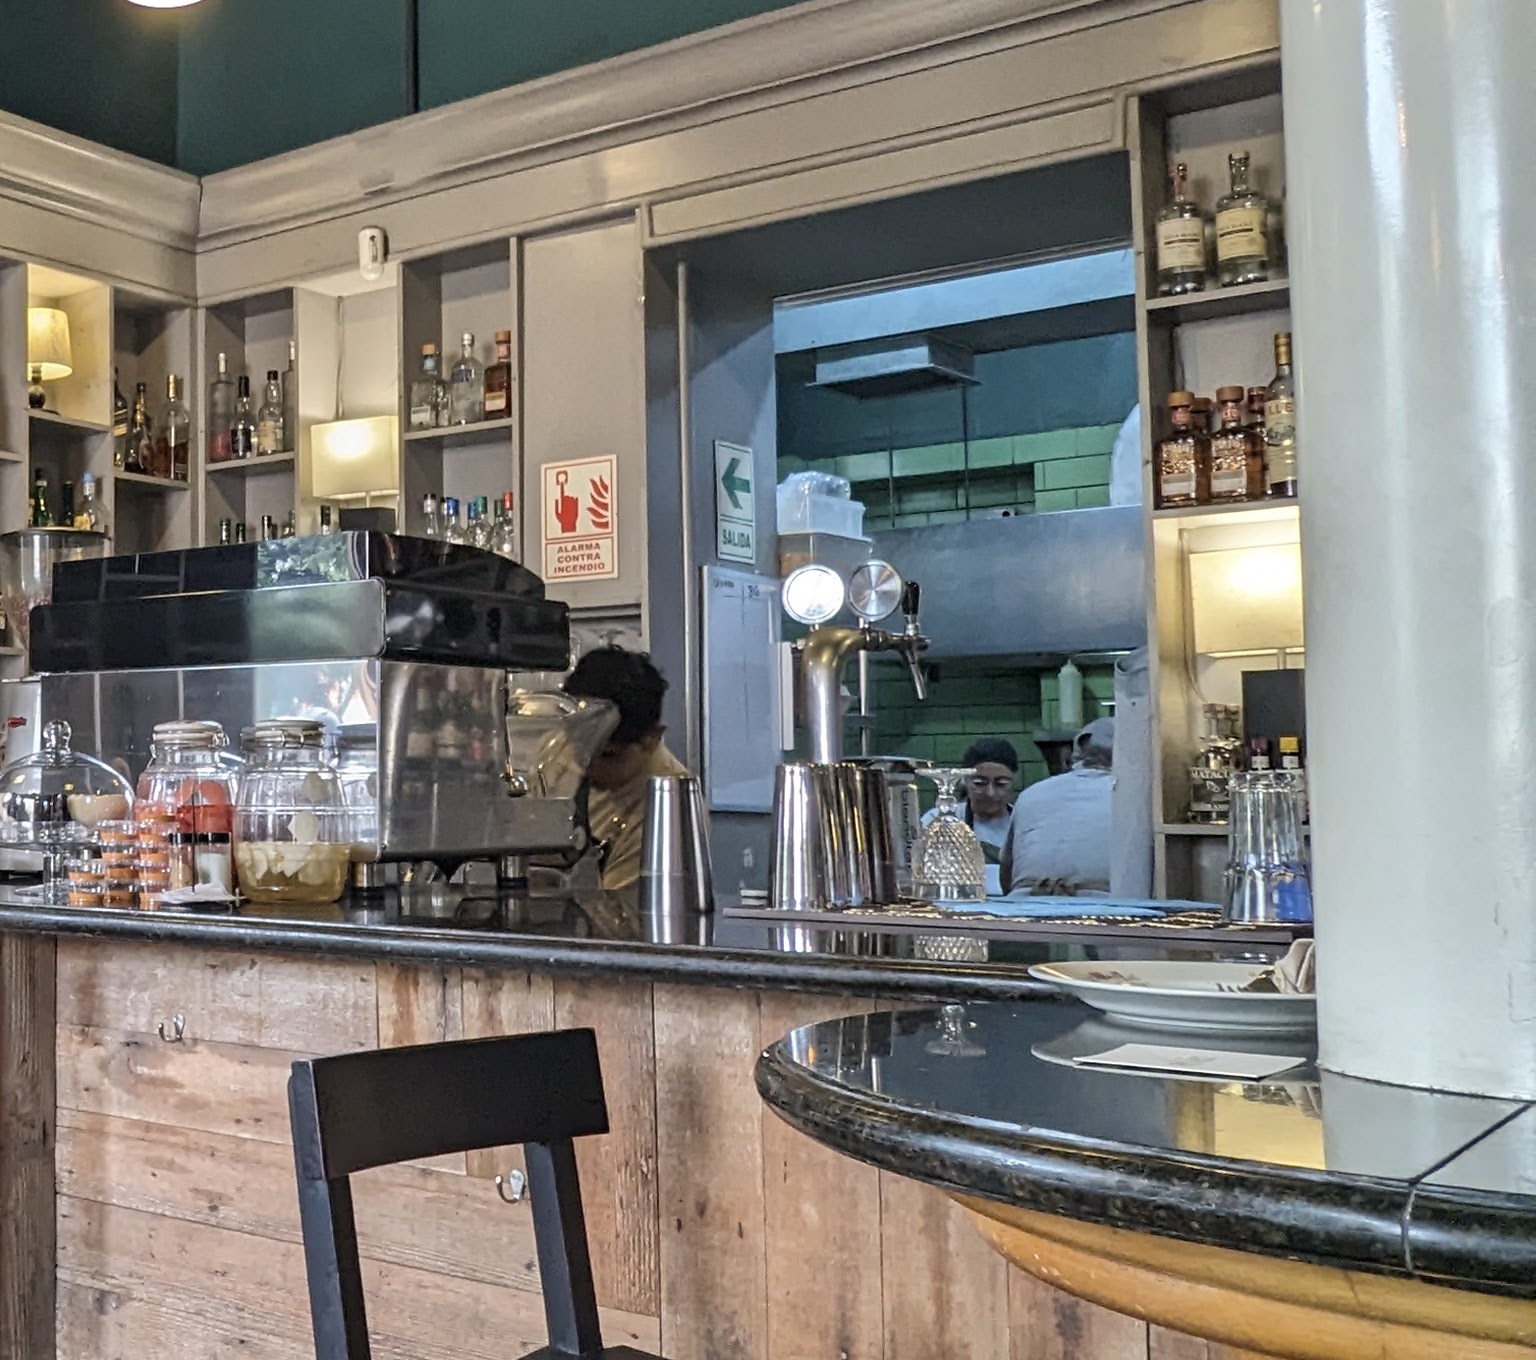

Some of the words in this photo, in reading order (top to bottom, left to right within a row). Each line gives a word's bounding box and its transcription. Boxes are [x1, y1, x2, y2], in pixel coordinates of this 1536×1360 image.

[722, 528, 751, 549] SALIDA
[557, 542, 601, 554] ALARMA
[557, 552, 601, 564] CONTRA
[554, 562, 605, 574] INCENDIO
